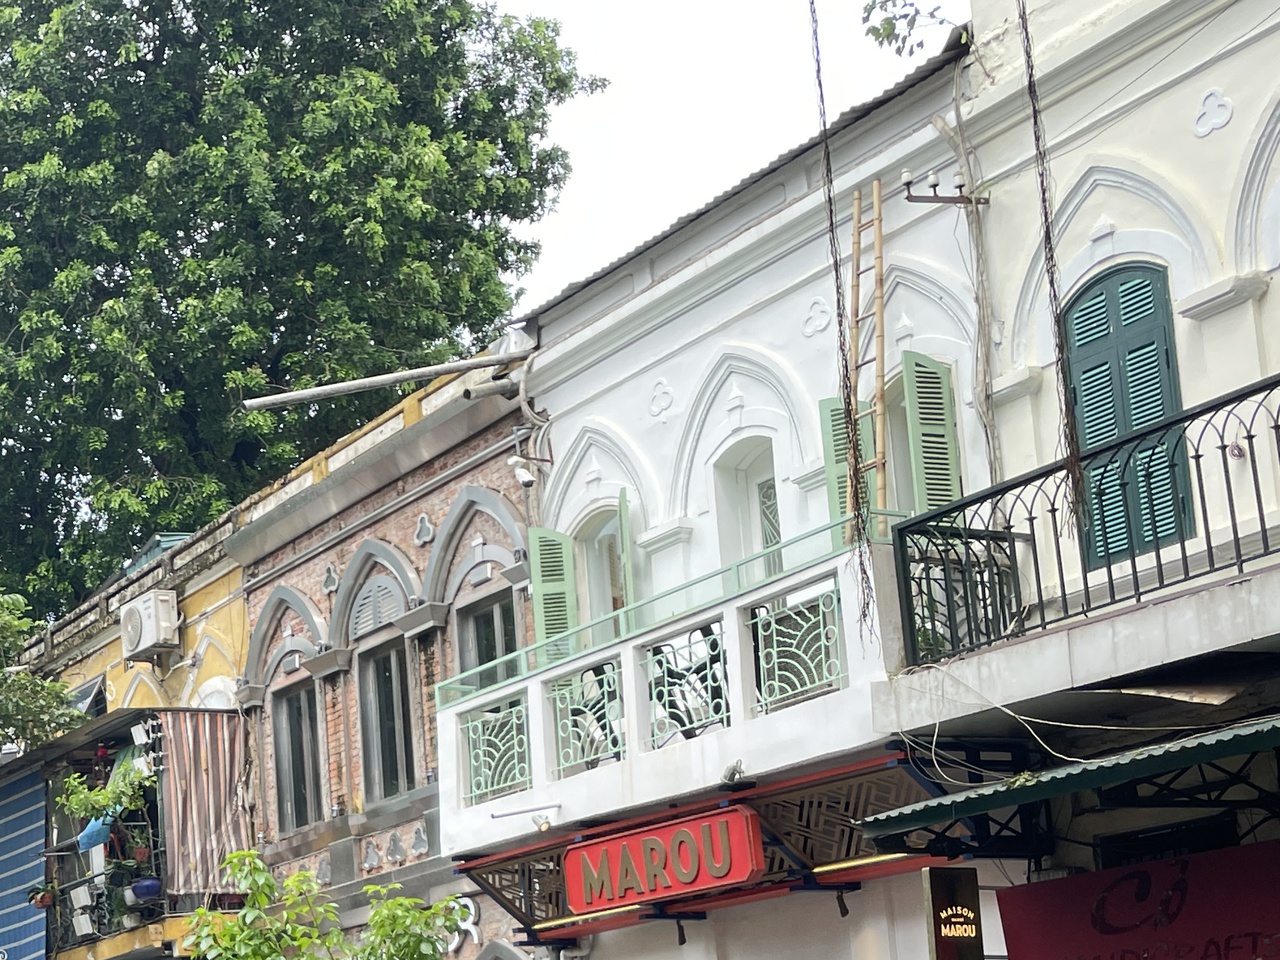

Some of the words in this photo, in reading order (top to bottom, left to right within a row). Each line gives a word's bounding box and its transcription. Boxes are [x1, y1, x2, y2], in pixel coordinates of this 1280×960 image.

[581, 819, 732, 905] MAROU
[939, 906, 975, 920] MAISON
[941, 923, 976, 937] MAROU
